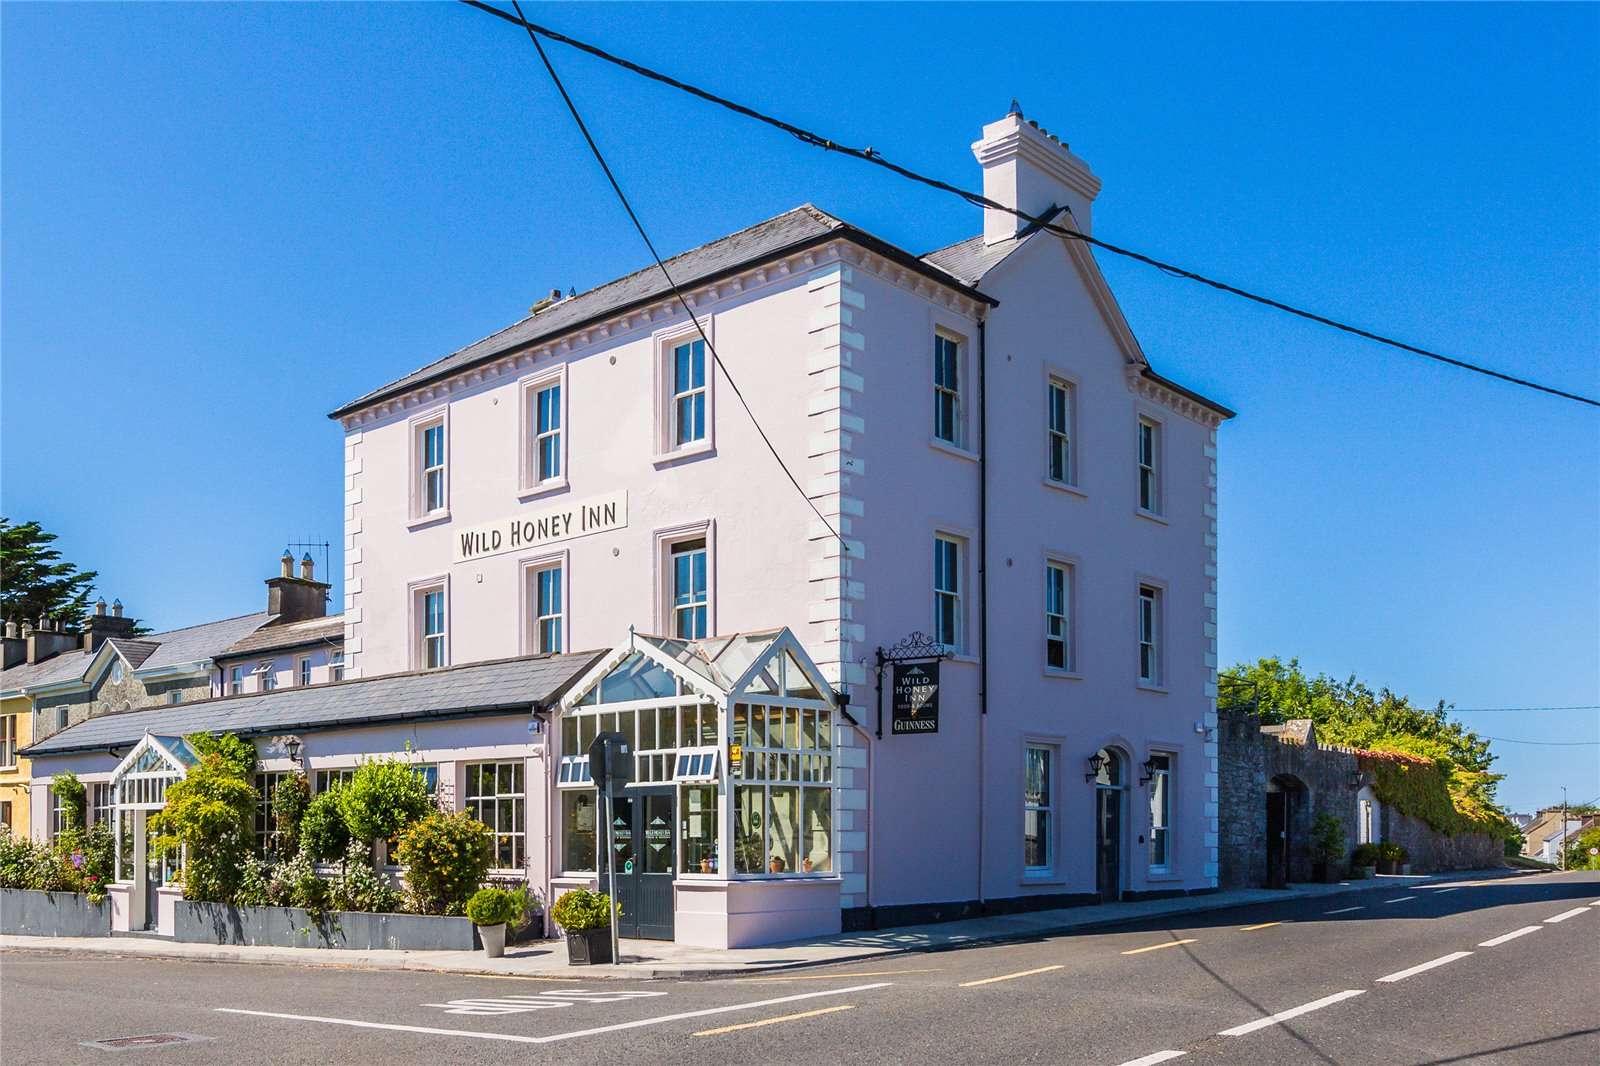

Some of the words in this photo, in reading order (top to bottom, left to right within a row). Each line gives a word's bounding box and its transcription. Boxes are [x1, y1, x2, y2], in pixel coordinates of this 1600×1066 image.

[461, 530, 502, 558] WILD
[511, 512, 572, 547] HONEY
[581, 502, 616, 531] INN
[902, 677, 930, 685] WILD
[896, 685, 935, 694] HONEY
[905, 694, 925, 702] INN
[894, 719, 935, 730] GUINNESS
